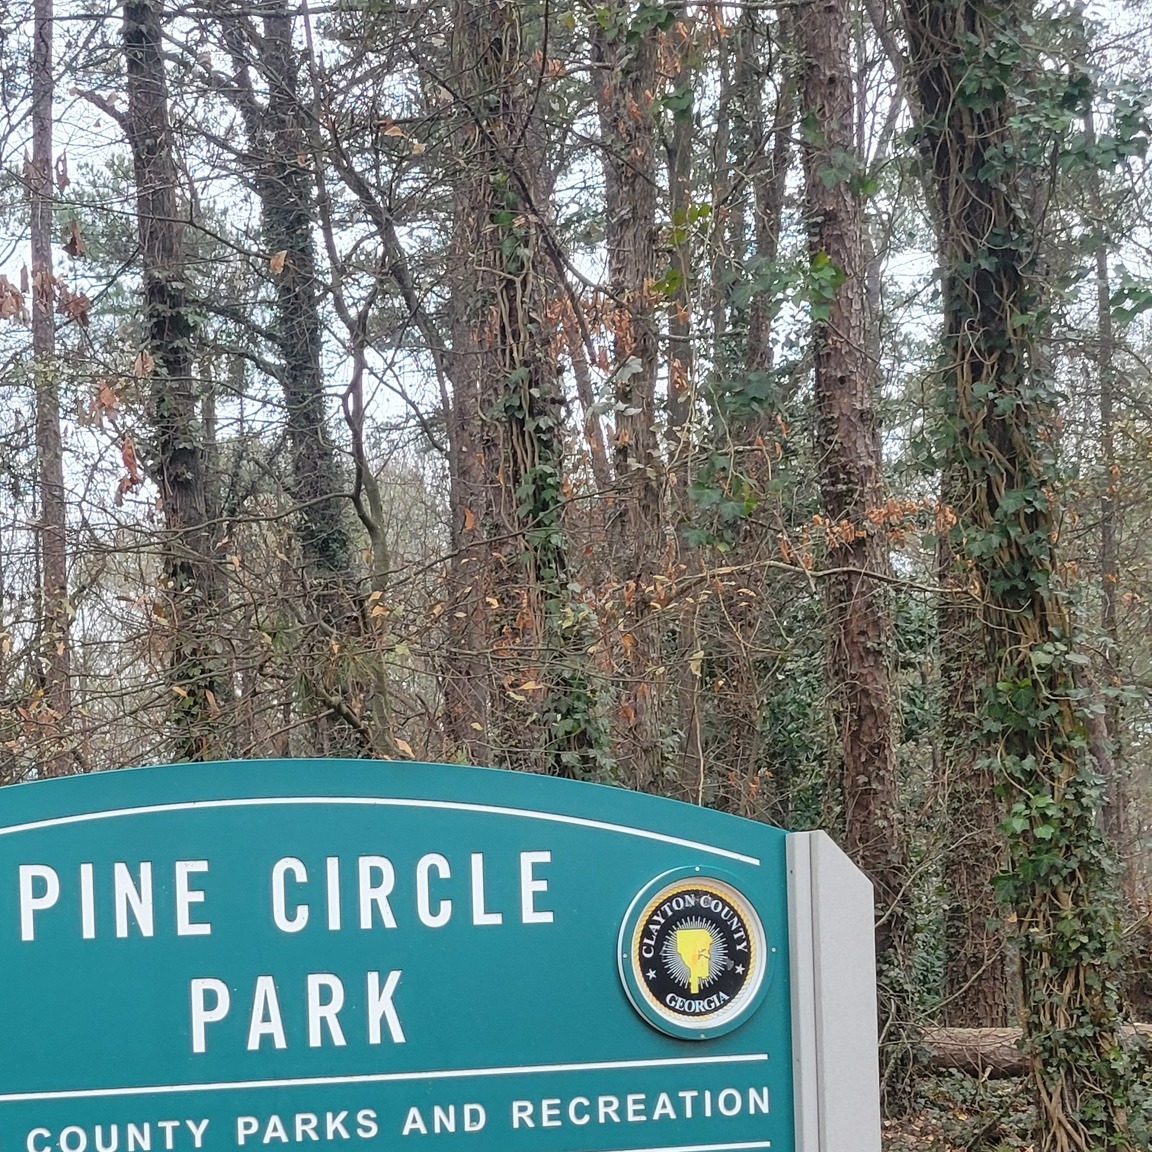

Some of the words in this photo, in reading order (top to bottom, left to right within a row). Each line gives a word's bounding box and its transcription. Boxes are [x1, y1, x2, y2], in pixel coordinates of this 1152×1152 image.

[20, 861, 210, 940] PINE
[272, 851, 553, 932] CIRCLE
[642, 893, 696, 958] CLAYTON
[699, 893, 748, 953] COUNTY
[191, 971, 405, 1052] PARK
[665, 991, 730, 1013] GEORGIA
[238, 1110, 377, 1145] PARKS
[403, 1104, 485, 1135] AND
[513, 1087, 768, 1128] RECREATION
